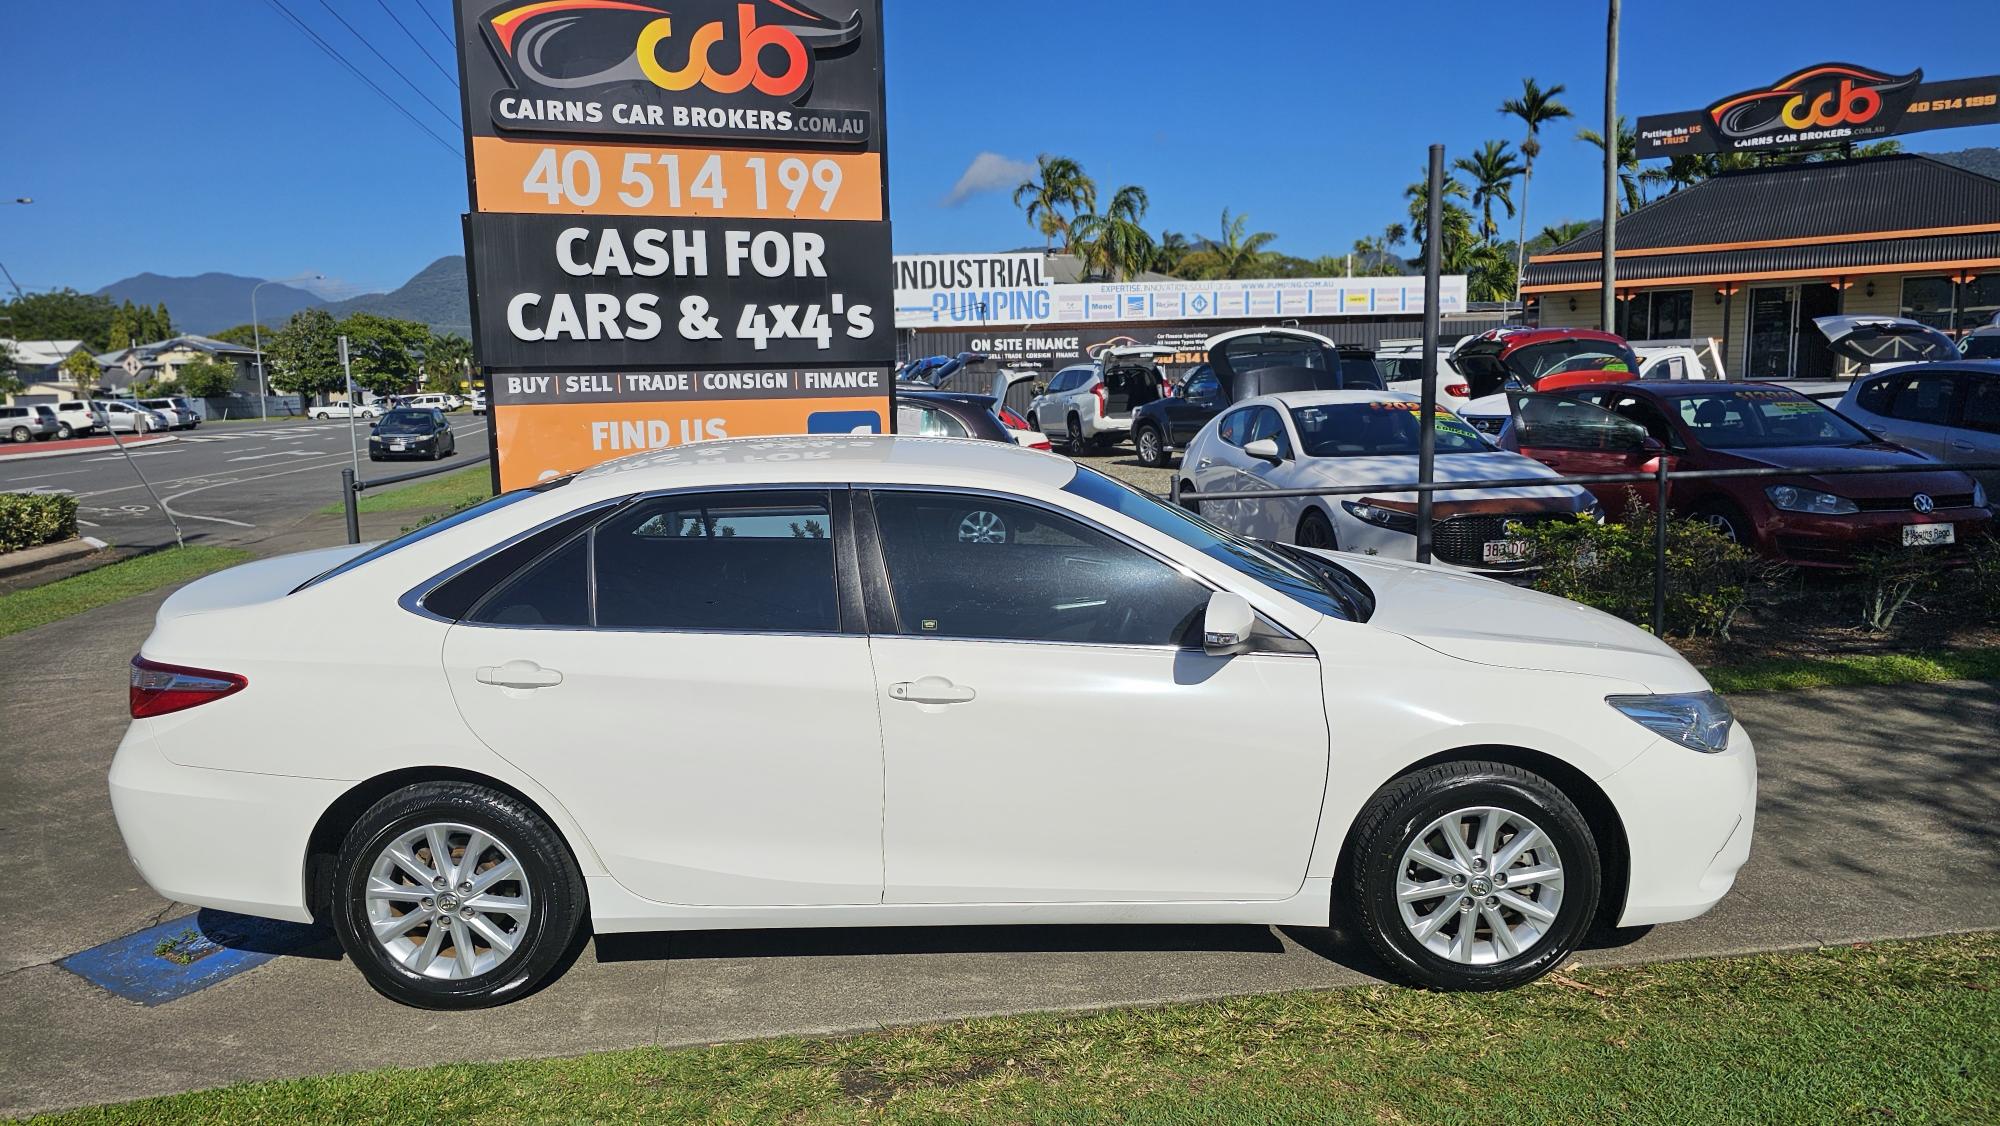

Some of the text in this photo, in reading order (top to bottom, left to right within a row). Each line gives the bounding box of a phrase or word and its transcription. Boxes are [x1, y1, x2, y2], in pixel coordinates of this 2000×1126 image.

[1906, 94, 1997, 113] 40 514 199
[499, 97, 864, 134] CAIRNS CAR BROKERS.COM.AU
[1642, 125, 1702, 140] Putting the US
[1662, 135, 1689, 145] TRUST
[1734, 134, 1773, 148] CAIRNS
[1776, 133, 1798, 144] CAR
[522, 147, 843, 212] 40 514 199
[555, 227, 828, 278] CASH FOR
[506, 292, 662, 341] CARS
[678, 295, 723, 340] &
[932, 290, 1050, 322] PUMPING
[971, 337, 1079, 351] ON SITE FINANCE
[1175, 352, 1201, 364] 514
[507, 371, 879, 394] BUY SELL TRADE CONSIGN FINANCE
[591, 417, 728, 451] FIND US
